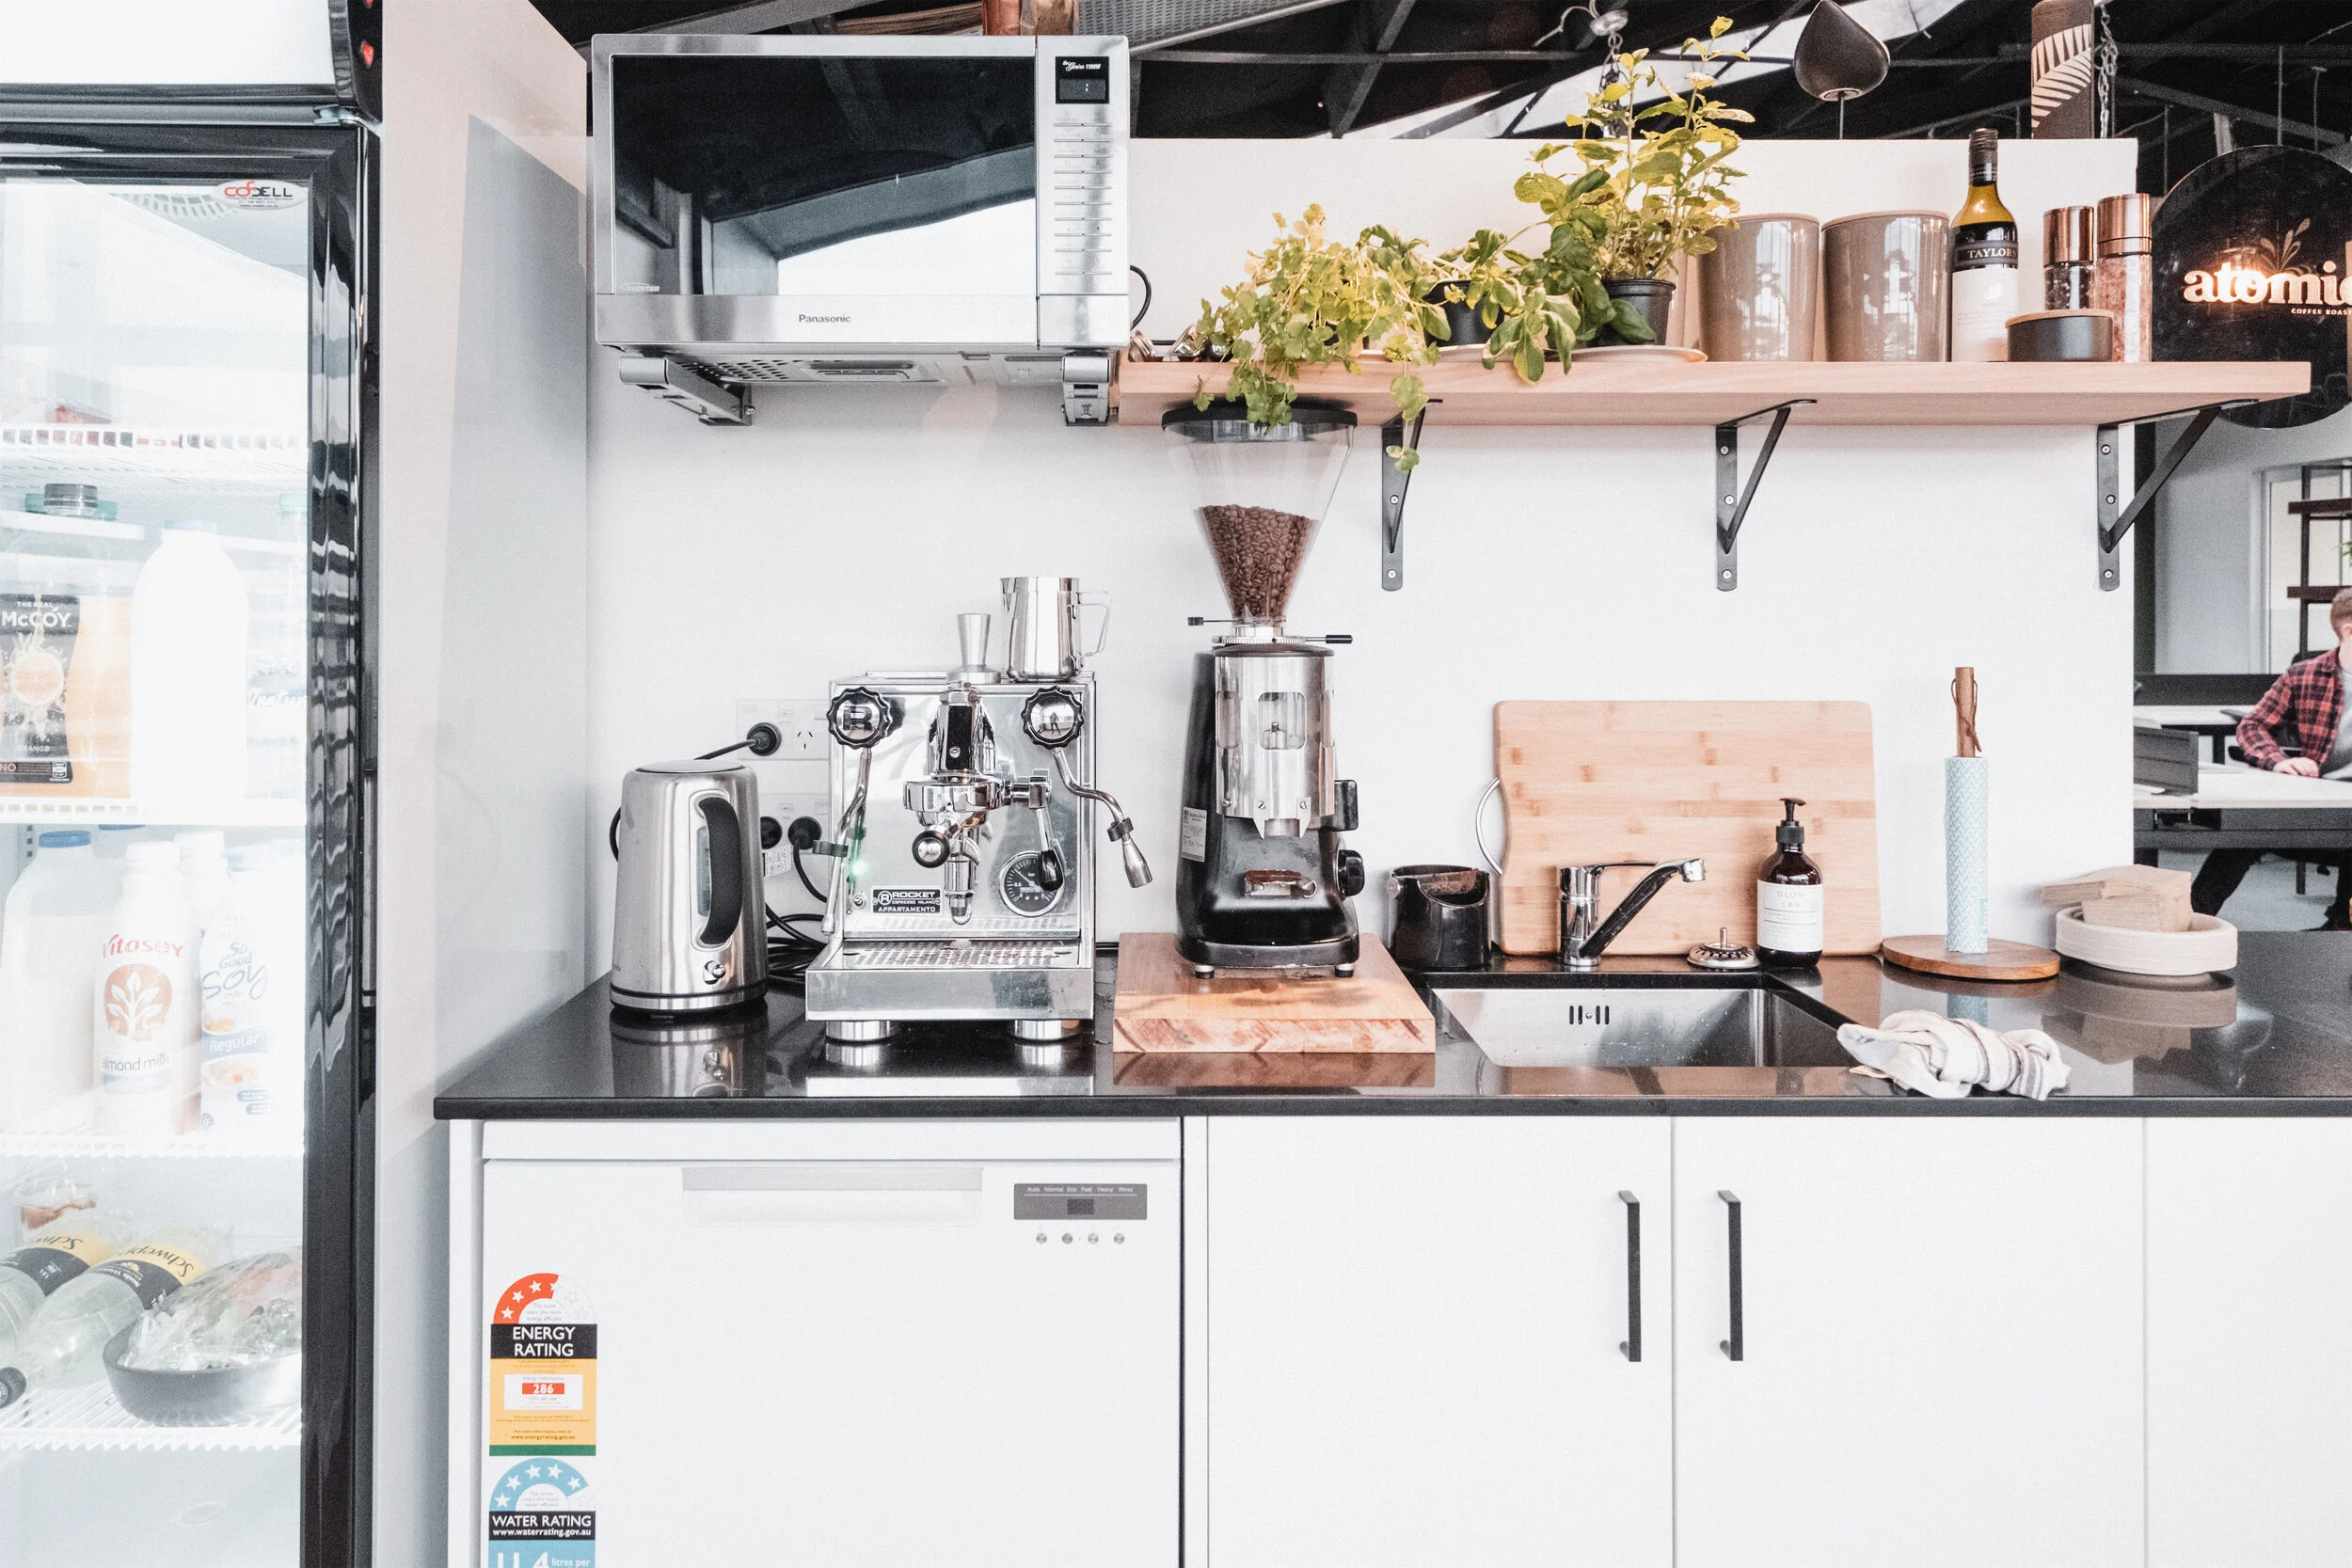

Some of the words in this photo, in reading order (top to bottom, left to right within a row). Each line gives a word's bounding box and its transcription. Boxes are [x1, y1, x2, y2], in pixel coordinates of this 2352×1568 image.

[1967, 247, 2017, 259] TAYLORS
[798, 314, 850, 324] Panasonic
[2, 610, 72, 628] McCOY
[0, 763, 17, 773] NO
[210, 1035, 260, 1054] Regular
[512, 1326, 576, 1340] ENERGY
[514, 1343, 574, 1356] RATING
[532, 1384, 554, 1394] 286
[491, 1515, 539, 1528] WATER
[541, 1515, 592, 1528] RATING
[492, 1528, 592, 1538] www.waterrating.gov.au
[551, 1558, 574, 1567] litres
[575, 1560, 591, 1568] per
